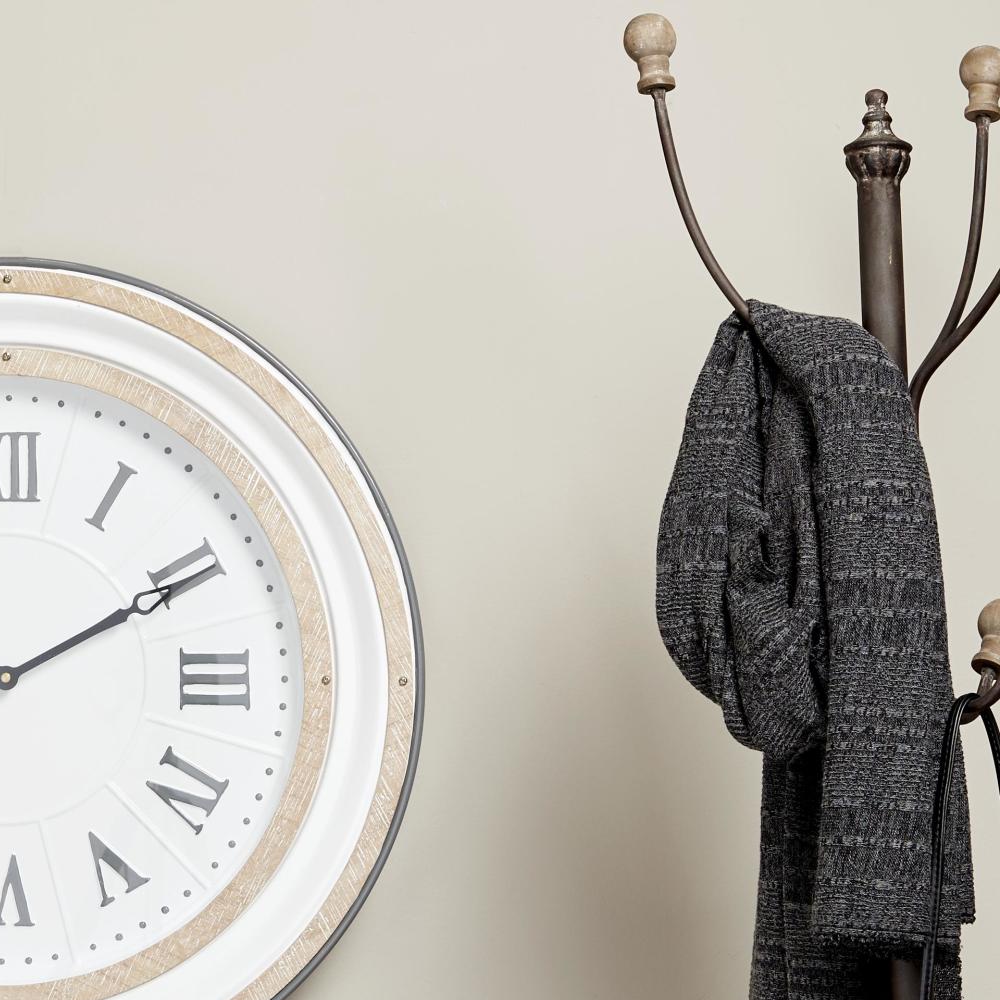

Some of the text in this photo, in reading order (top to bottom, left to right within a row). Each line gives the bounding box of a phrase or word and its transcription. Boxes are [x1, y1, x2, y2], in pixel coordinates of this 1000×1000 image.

[84, 460, 138, 532] I
[146, 536, 227, 610] II
[179, 647, 251, 711] III
[145, 745, 230, 836] IV
[87, 830, 151, 908] V
